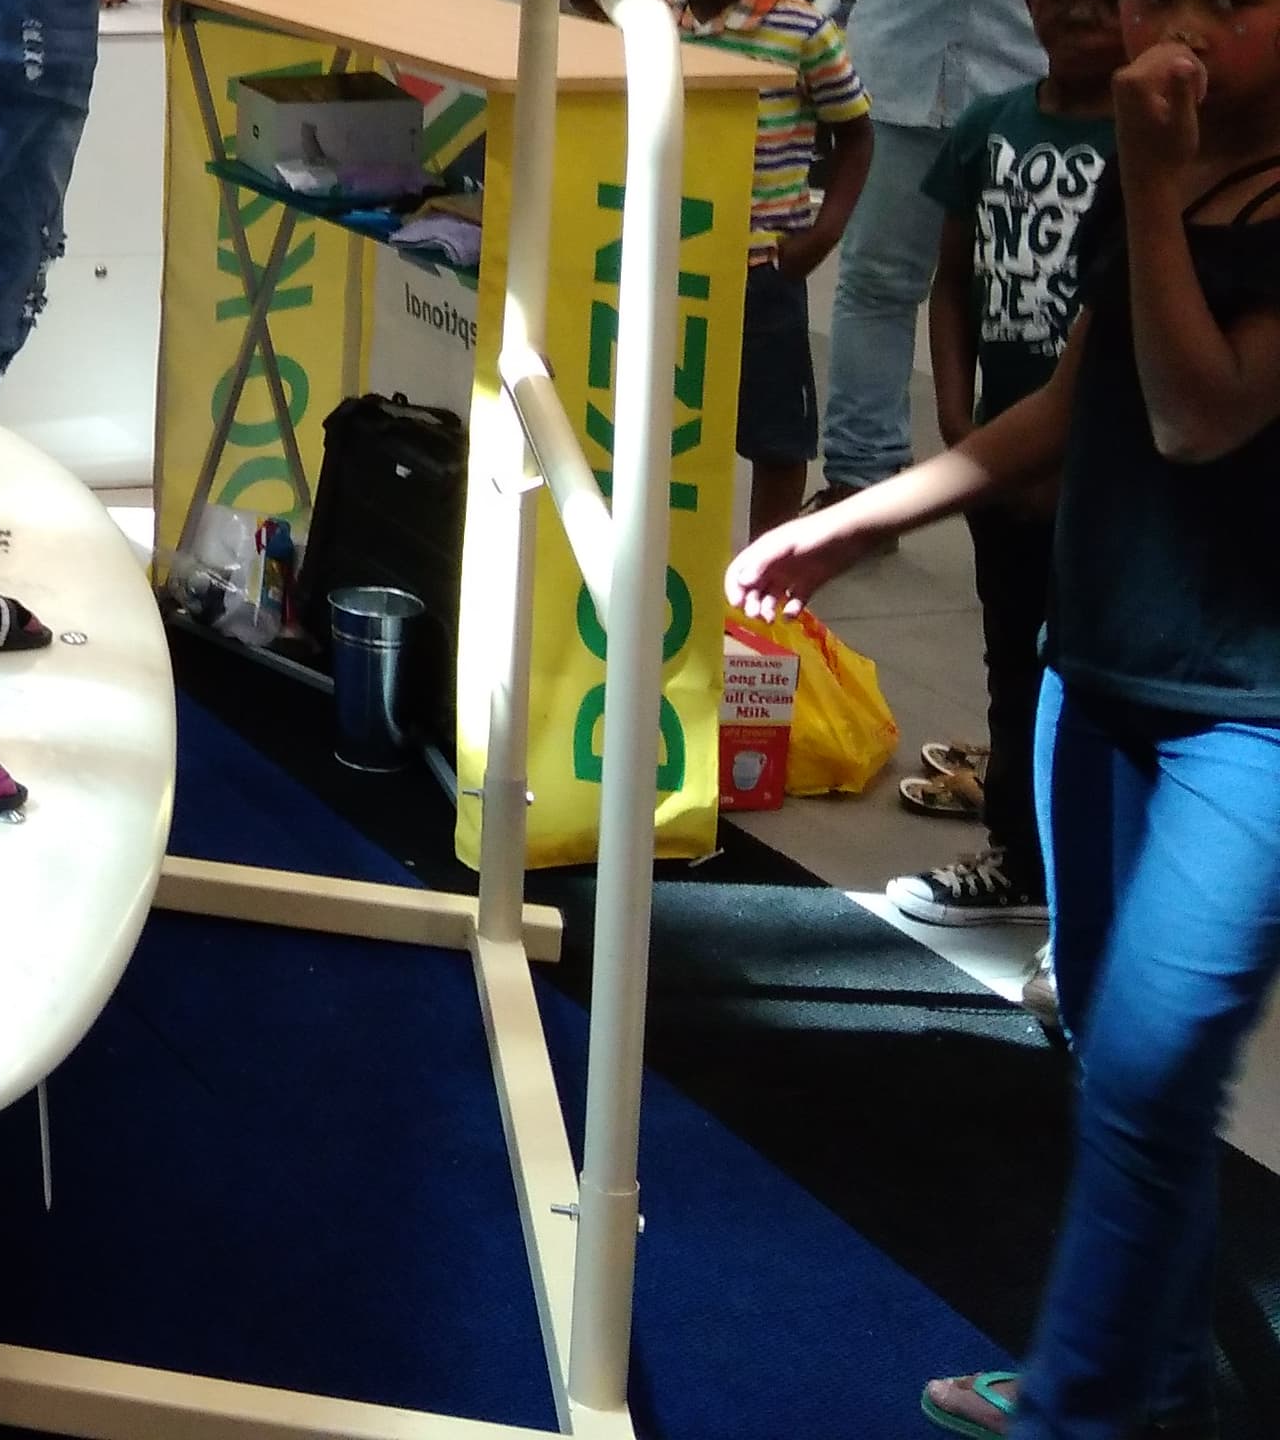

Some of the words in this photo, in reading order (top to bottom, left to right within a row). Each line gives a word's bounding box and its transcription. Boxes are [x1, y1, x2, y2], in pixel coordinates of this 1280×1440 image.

[986, 133, 1106, 200] LOS
[759, 672, 790, 686] Life
[723, 691, 745, 704] ull
[748, 692, 794, 705] Cream
[735, 706, 771, 719] Milk
